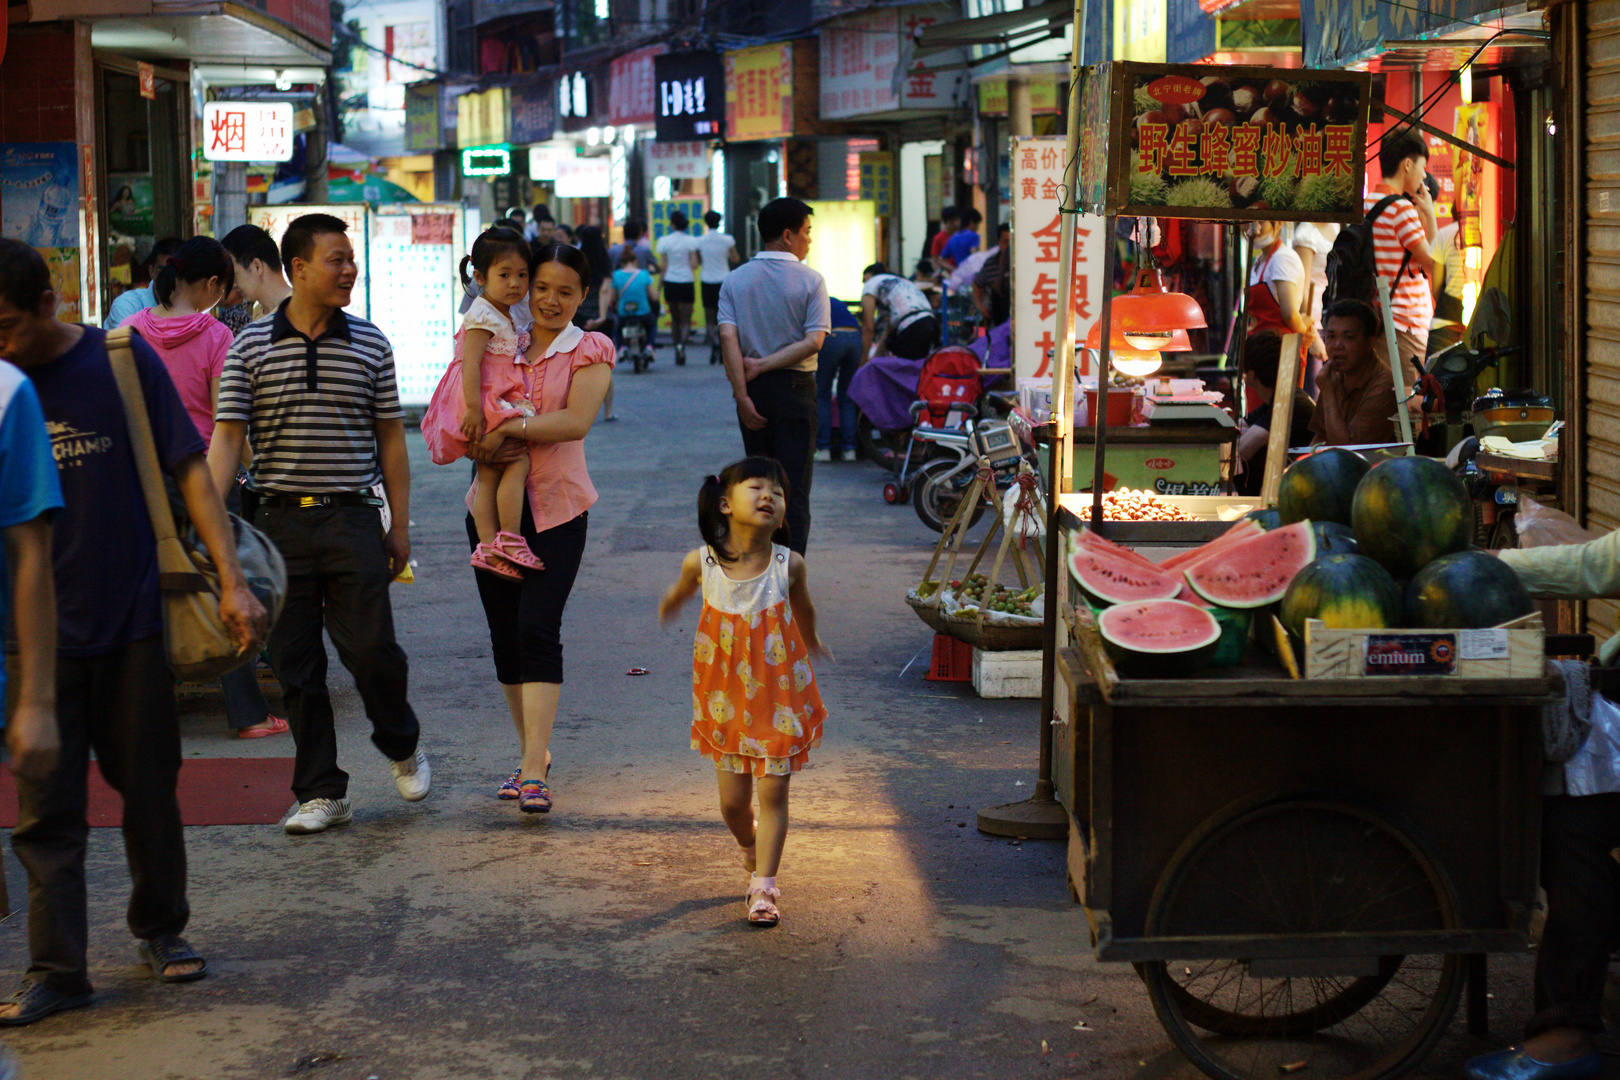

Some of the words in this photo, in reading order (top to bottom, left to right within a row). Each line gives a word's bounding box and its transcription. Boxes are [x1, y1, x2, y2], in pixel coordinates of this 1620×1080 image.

[1152, 84, 1203, 98] 北宁街老牌
[211, 109, 245, 152] 烟
[1021, 147, 1066, 171] 高价
[1138, 121, 1354, 179] 野生蜂蜜炒油栗
[1021, 177, 1065, 200] 黄金
